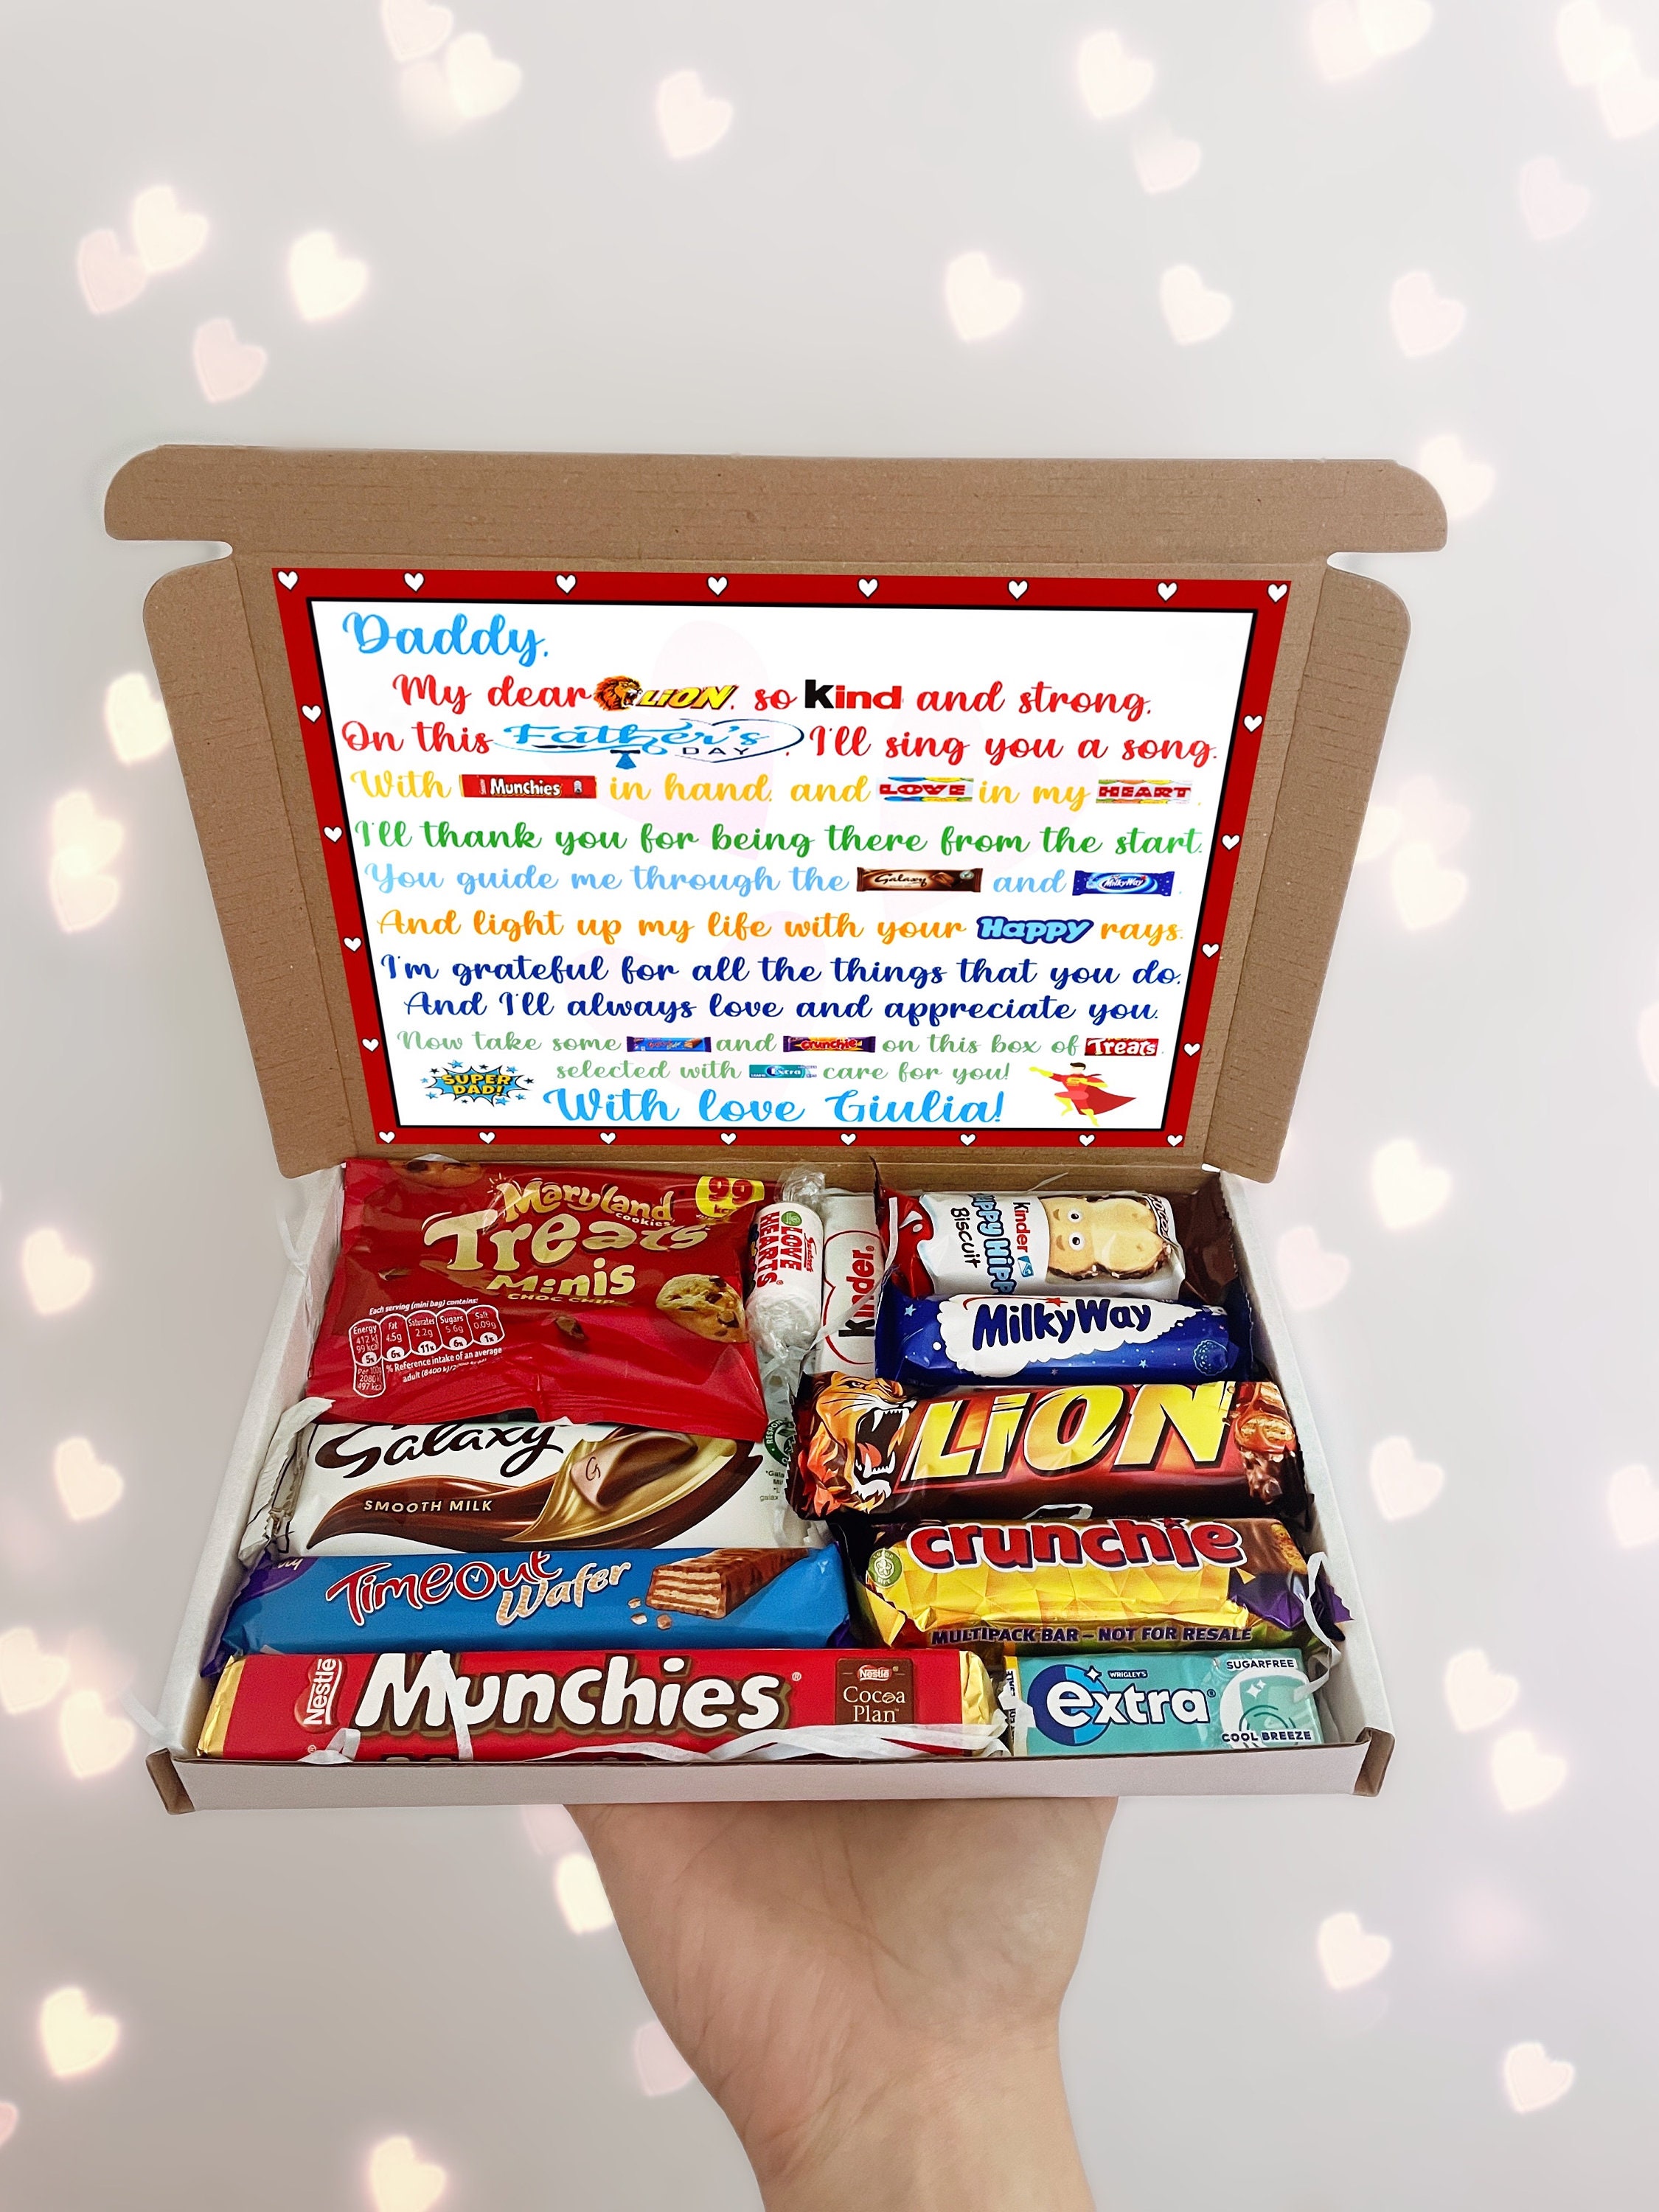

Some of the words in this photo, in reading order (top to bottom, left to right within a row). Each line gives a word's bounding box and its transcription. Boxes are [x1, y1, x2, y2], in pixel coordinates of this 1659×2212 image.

[393, 674, 472, 716] My
[488, 675, 591, 709] dear
[754, 686, 799, 712] so
[804, 678, 902, 709] kind
[917, 681, 1006, 714] and
[341, 720, 404, 753] On
[411, 720, 493, 754] this
[503, 723, 769, 755] Father's
[810, 726, 872, 757] I'll
[885, 731, 970, 765] sing
[984, 735, 1065, 766] you
[1077, 738, 1109, 759] a
[1122, 739, 1219, 768] song.
[349, 770, 451, 799] With
[490, 778, 560, 796] Munchies
[611, 776, 652, 801] in
[790, 775, 872, 804] and
[879, 783, 966, 797] LOVE
[978, 780, 1019, 804] in
[1033, 782, 1091, 813] my
[355, 820, 413, 848] I'll
[420, 820, 543, 849] thank
[555, 829, 628, 858] you
[641, 823, 699, 853] for
[712, 823, 815, 858] being
[824, 824, 928, 854] there
[940, 826, 1030, 855] from
[1040, 826, 1103, 854] the
[1115, 827, 1203, 855] start.
[364, 862, 445, 894] You
[457, 863, 560, 895] guide
[571, 872, 622, 890] me
[630, 864, 781, 896] through
[788, 866, 849, 893] the
[874, 873, 927, 887] Galaxy
[993, 869, 1068, 894] and
[377, 908, 462, 936] And
[473, 910, 564, 942] light
[577, 918, 622, 945] up
[639, 919, 695, 943] my
[708, 911, 772, 941] life
[785, 912, 865, 939] with
[877, 919, 967, 946] your
[978, 915, 1093, 945] Happy
[1100, 921, 1183, 946] rays.
[380, 953, 439, 981] I'm
[452, 955, 608, 987] grateful
[621, 956, 679, 984] for
[692, 956, 751, 982] all
[757, 956, 822, 983] the
[830, 958, 947, 990] things
[956, 957, 1038, 985] that
[1050, 964, 1121, 991] you
[403, 991, 487, 1016] And
[498, 991, 555, 1017] I'll
[567, 992, 697, 1023] always
[709, 992, 783, 1018] love
[796, 994, 873, 1019] and
[884, 995, 1077, 1028] appreciate
[1088, 1001, 1158, 1028] you.
[397, 1030, 466, 1051] Now
[471, 1031, 543, 1051] take
[552, 1036, 622, 1051] some
[715, 1032, 778, 1052] and
[882, 1037, 919, 1054] on
[926, 1034, 981, 1054] this
[991, 1034, 1042, 1054] box
[1051, 1034, 1079, 1057] of
[1088, 1038, 1155, 1056] Treats
[442, 1073, 512, 1086] SUPER
[557, 1060, 670, 1079] selected
[679, 1061, 742, 1079] with
[823, 1065, 888, 1081] care
[897, 1062, 947, 1082] for
[952, 1062, 1010, 1085] you!
[453, 1084, 504, 1096] DAD!
[543, 1088, 680, 1121] With
[698, 1088, 805, 1122] love
[824, 1089, 1004, 1123] Giulia!
[498, 1178, 675, 1222] Maryland
[709, 1177, 754, 1205] 99
[615, 1212, 671, 1227] cookies
[424, 1209, 709, 1272] Treats
[757, 1211, 780, 1289] HEARTS
[780, 1226, 802, 1271] LOVE
[950, 1208, 981, 1268] Biscuit
[486, 1256, 636, 1297] Minis
[369, 1307, 384, 1315] Each
[385, 1303, 410, 1313] serving
[411, 1301, 429, 1311] (mini
[430, 1299, 446, 1309] bag)
[507, 1293, 563, 1302] CHOC
[389, 1321, 398, 1330] Fat
[439, 1315, 464, 1325] Sugars
[473, 1321, 497, 1329] 0.09g
[475, 1311, 489, 1320] Salt
[353, 1325, 378, 1335] Energy
[386, 1332, 403, 1343] 4.5g
[415, 1328, 434, 1338] 2.2g
[356, 1346, 366, 1354] 99
[395, 1358, 431, 1371] Reference
[431, 1354, 455, 1364] intake
[455, 1352, 463, 1360] of
[464, 1352, 473, 1360] an
[474, 1347, 502, 1357] average
[403, 1371, 420, 1383] adult
[315, 1425, 563, 1478] Galaxy
[364, 1500, 442, 1513] SMOOTH
[450, 1500, 493, 1512] MILK
[496, 1560, 631, 1627] Wafer
[932, 1627, 1034, 1644] MULTIPACK
[1040, 1629, 1079, 1643] BAR
[1098, 1628, 1138, 1642] NOT
[1142, 1627, 1178, 1641] FOR
[1183, 1627, 1252, 1641] RESALE
[1110, 1670, 1146, 1678] WRIGLEY'S
[1227, 1658, 1295, 1669] SUGARFREE
[355, 1652, 780, 1730] Munchies
[844, 1686, 906, 1704] Cocoa
[1046, 1680, 1210, 1727] extra
[1221, 1731, 1258, 1742] COOL
[1262, 1730, 1312, 1741] BREEZE
